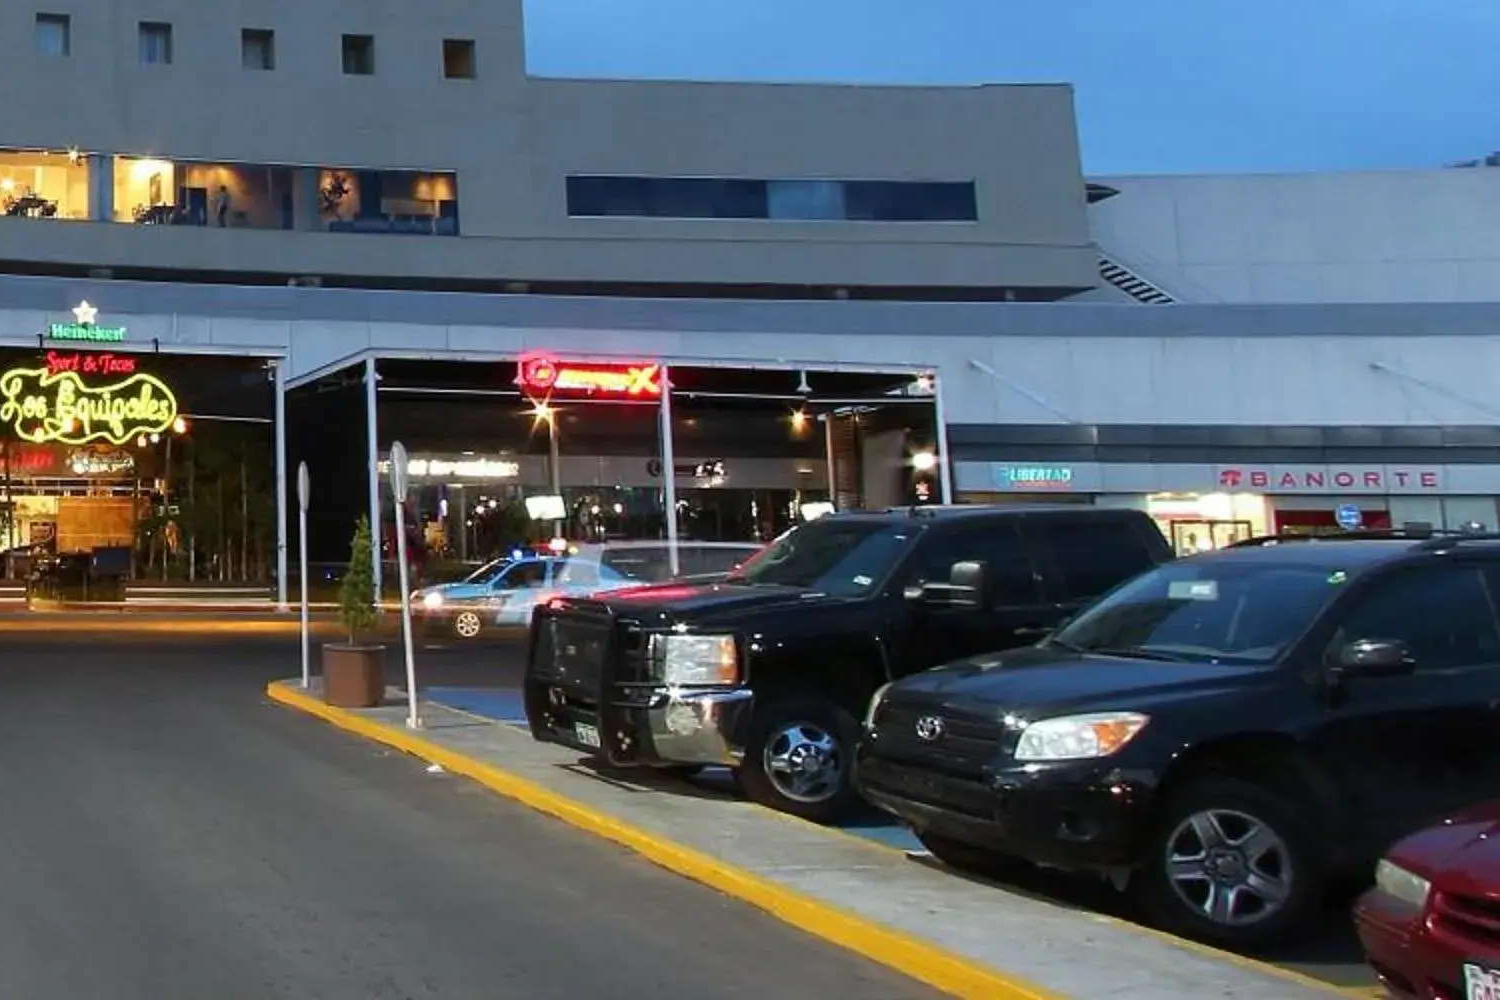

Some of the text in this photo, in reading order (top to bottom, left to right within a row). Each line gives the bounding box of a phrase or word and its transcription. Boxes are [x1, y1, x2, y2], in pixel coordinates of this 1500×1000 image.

[51, 323, 127, 341] Heineken
[0, 377, 47, 421] Los
[1009, 467, 1071, 482] LIBERTAD
[1250, 471, 1438, 488] BANORTE
